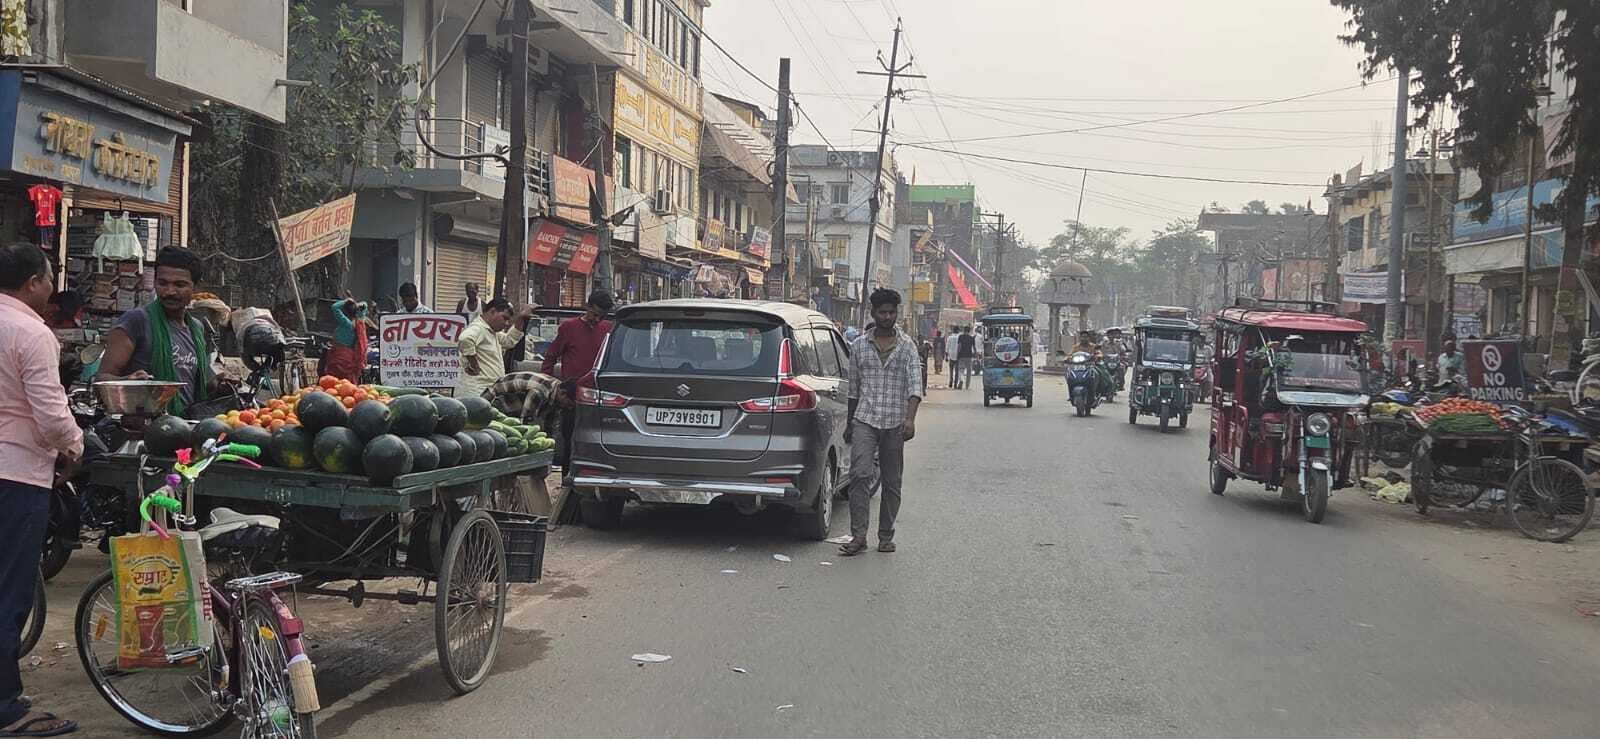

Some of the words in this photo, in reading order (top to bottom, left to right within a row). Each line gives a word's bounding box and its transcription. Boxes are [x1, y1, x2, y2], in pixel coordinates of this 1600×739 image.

[383, 317, 465, 343] नायरा
[1483, 372, 1505, 386] NO
[1471, 387, 1524, 401] PARKING
[655, 411, 715, 426] UP79V8901
